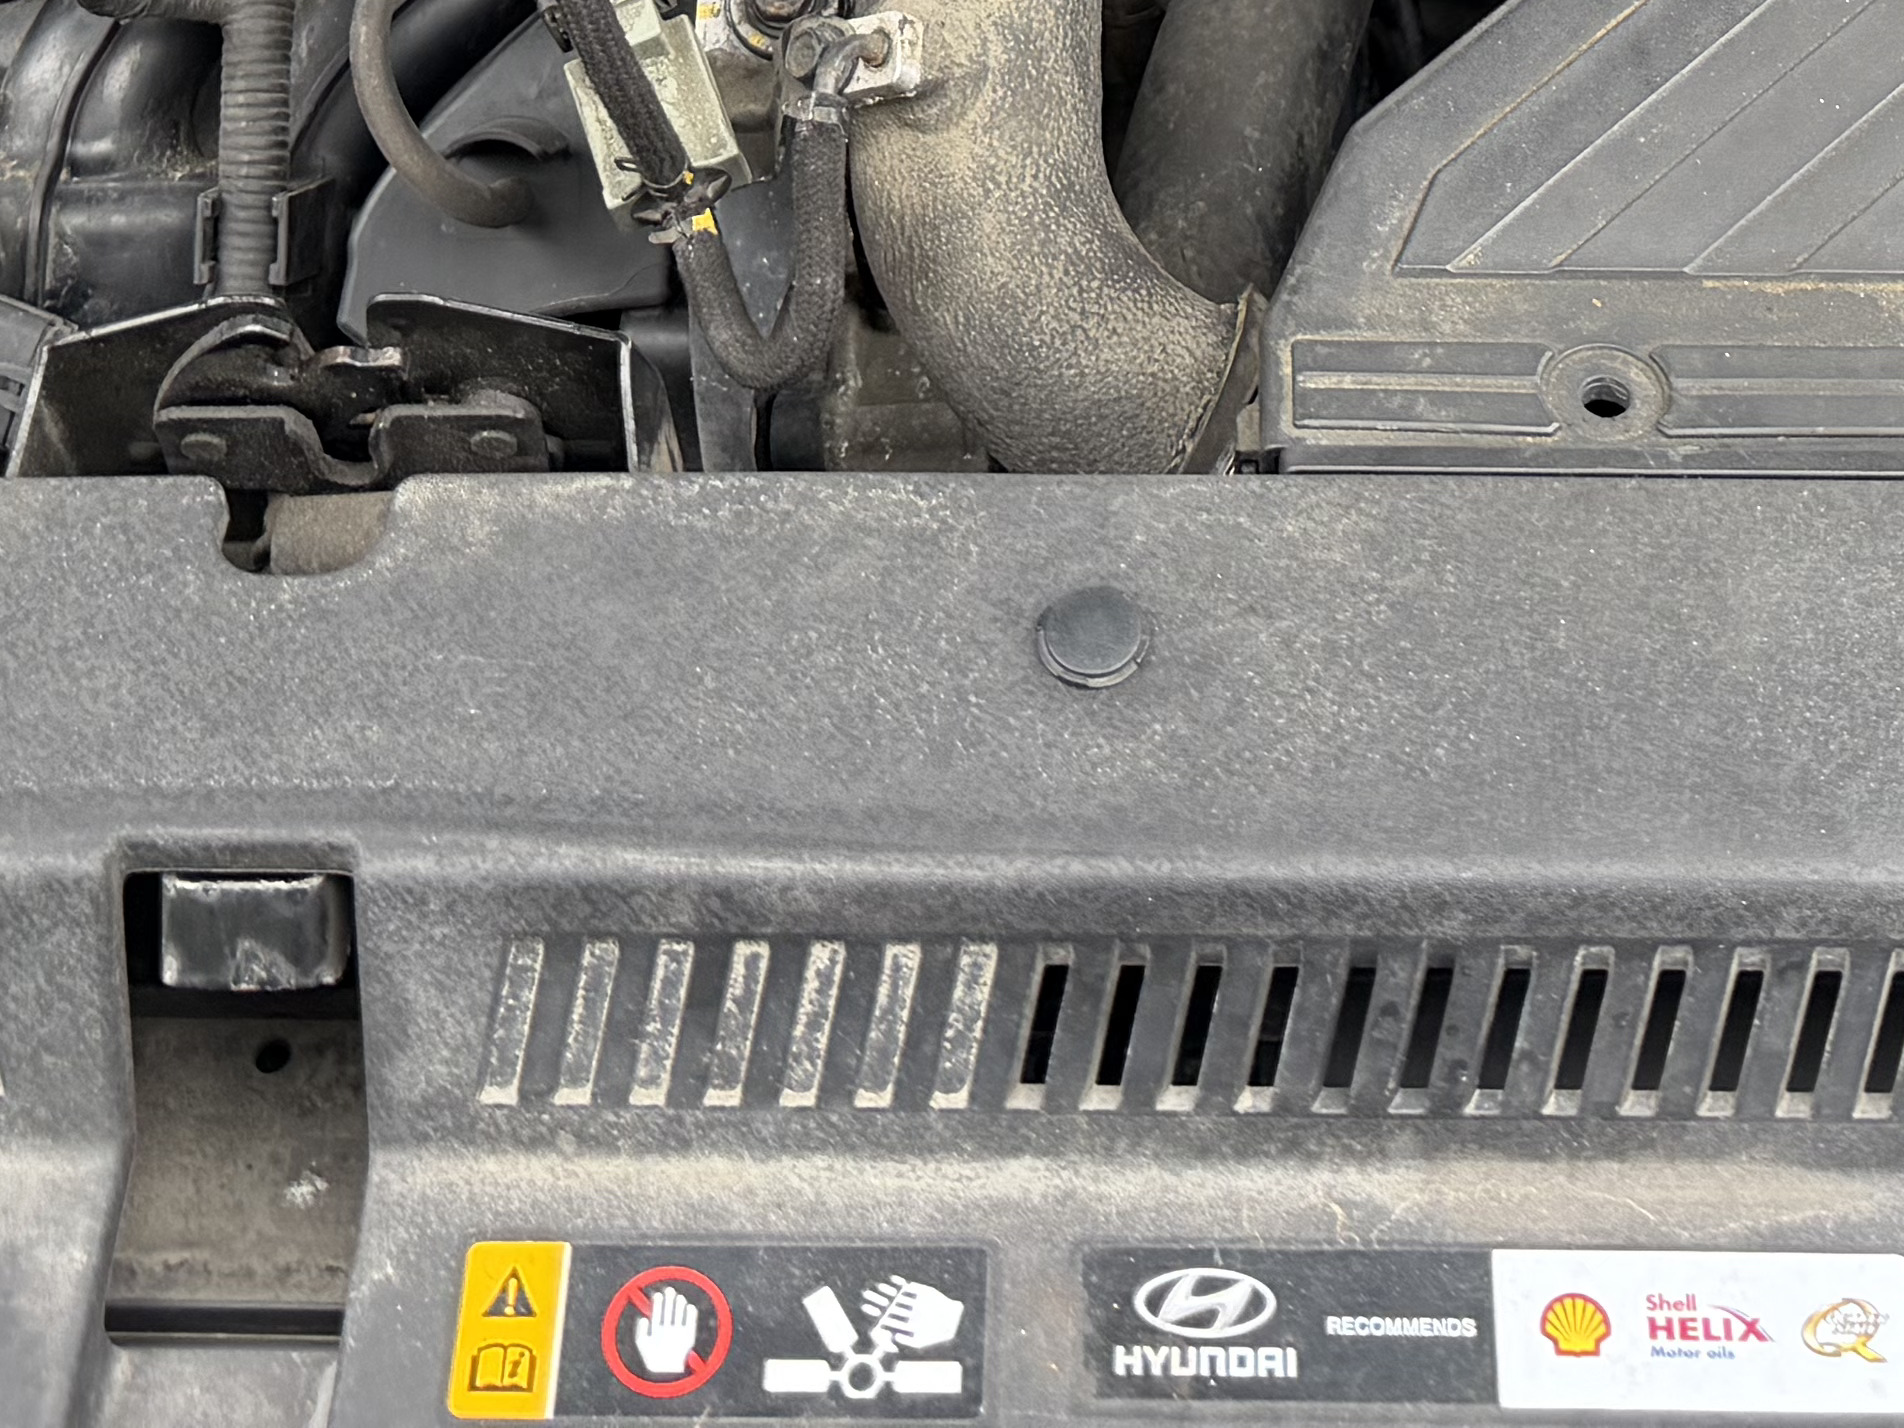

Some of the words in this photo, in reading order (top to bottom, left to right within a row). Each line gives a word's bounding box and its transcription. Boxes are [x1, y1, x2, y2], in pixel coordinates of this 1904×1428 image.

[1646, 1294, 1697, 1312] Shell
[1647, 1316, 1776, 1342] HELIX
[1113, 1346, 1298, 1379] HYUNDAI
[1326, 1315, 1478, 1338] RECOMMENDS
[1650, 1346, 1701, 1359] Motor
[1706, 1346, 1736, 1360] oils
